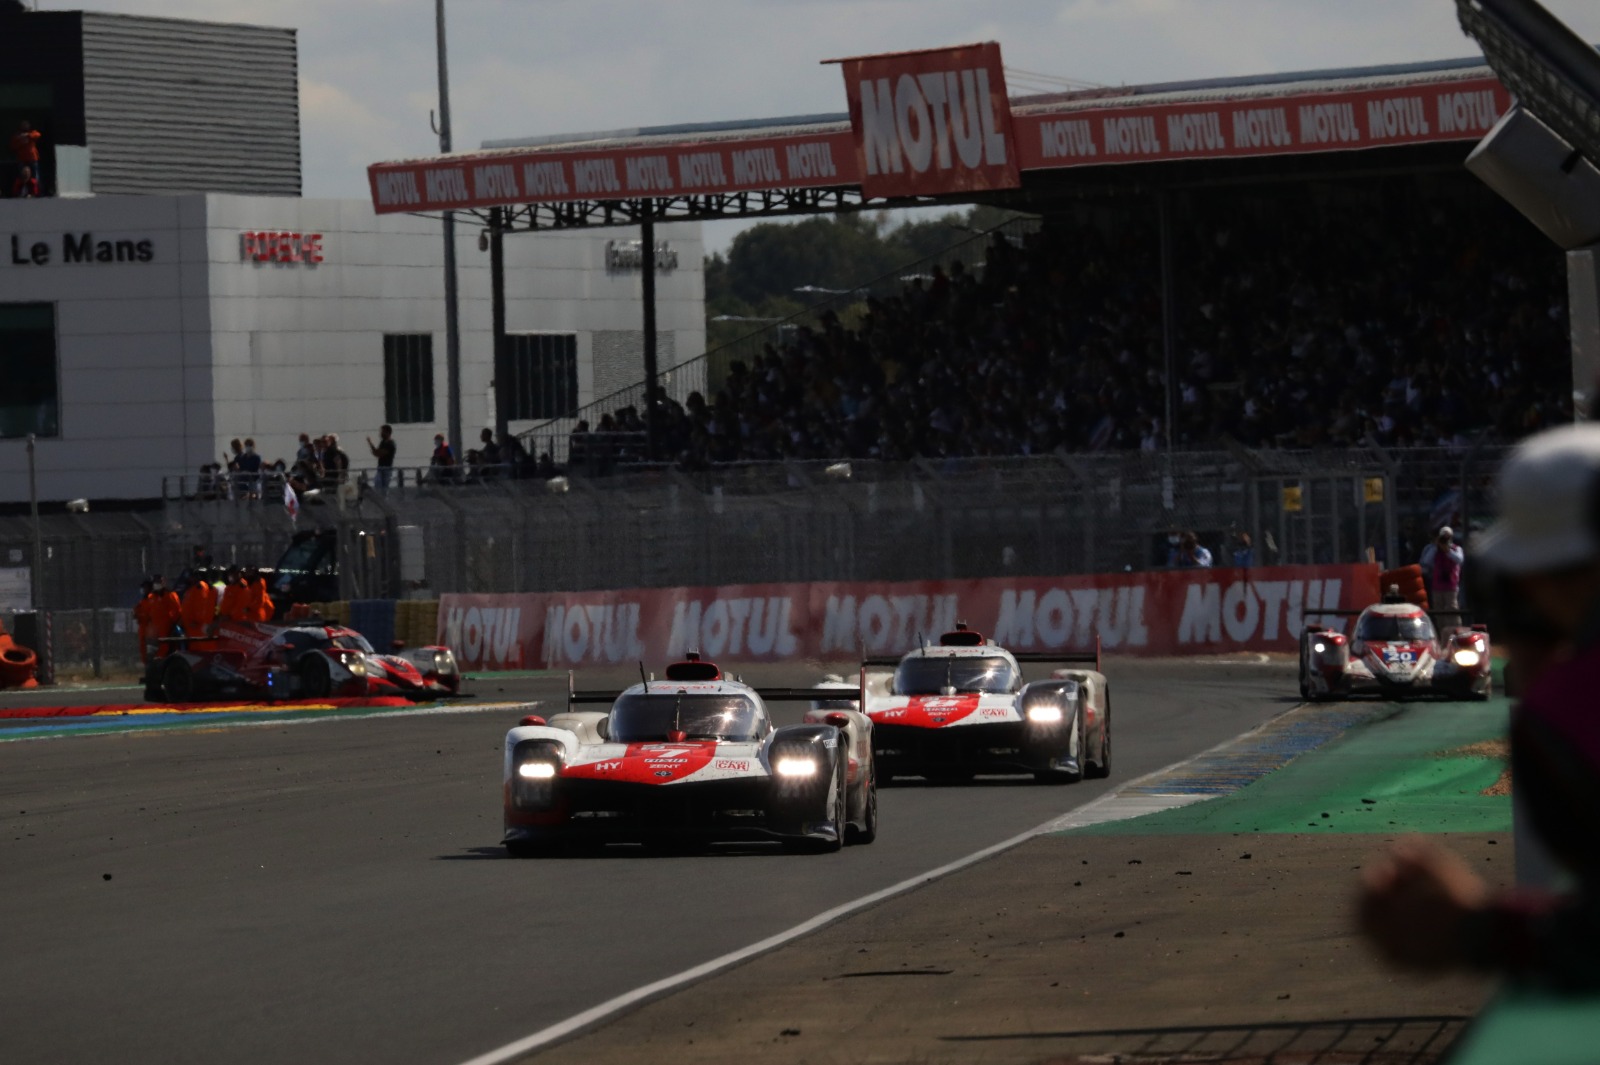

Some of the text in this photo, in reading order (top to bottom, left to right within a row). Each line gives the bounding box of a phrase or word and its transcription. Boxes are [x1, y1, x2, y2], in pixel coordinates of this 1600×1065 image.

[860, 68, 1007, 176] MOTUL
[1232, 108, 1292, 148] MOTUL
[1298, 103, 1360, 143] MOTUL
[1367, 97, 1429, 139] MOTUL
[1437, 90, 1499, 133] MOTUL
[1040, 119, 1097, 158] MOTUL
[1103, 116, 1161, 155] MOTUL
[1167, 112, 1225, 152] MOTUL
[523, 161, 569, 195] MOTUL
[573, 158, 620, 192] MOTUL
[626, 156, 673, 190] MOTUL
[678, 152, 727, 188] MOTUL
[732, 148, 781, 184] MOTUL
[786, 142, 837, 179] MOTUL
[376, 171, 420, 205] MOTUL
[425, 168, 469, 202] MOTUL
[474, 165, 519, 199] MOTUL
[11, 233, 154, 265] Le Mans
[667, 596, 797, 657] MOTUL
[994, 586, 1149, 647] MOTUL
[1178, 578, 1348, 642] MOTUL
[445, 606, 520, 663] MOTUL
[542, 602, 645, 663] MOTUL
[1388, 652, 1412, 661] 20
[597, 761, 620, 770] HY
[650, 749, 690, 758] 7
[719, 762, 746, 770] CAR
